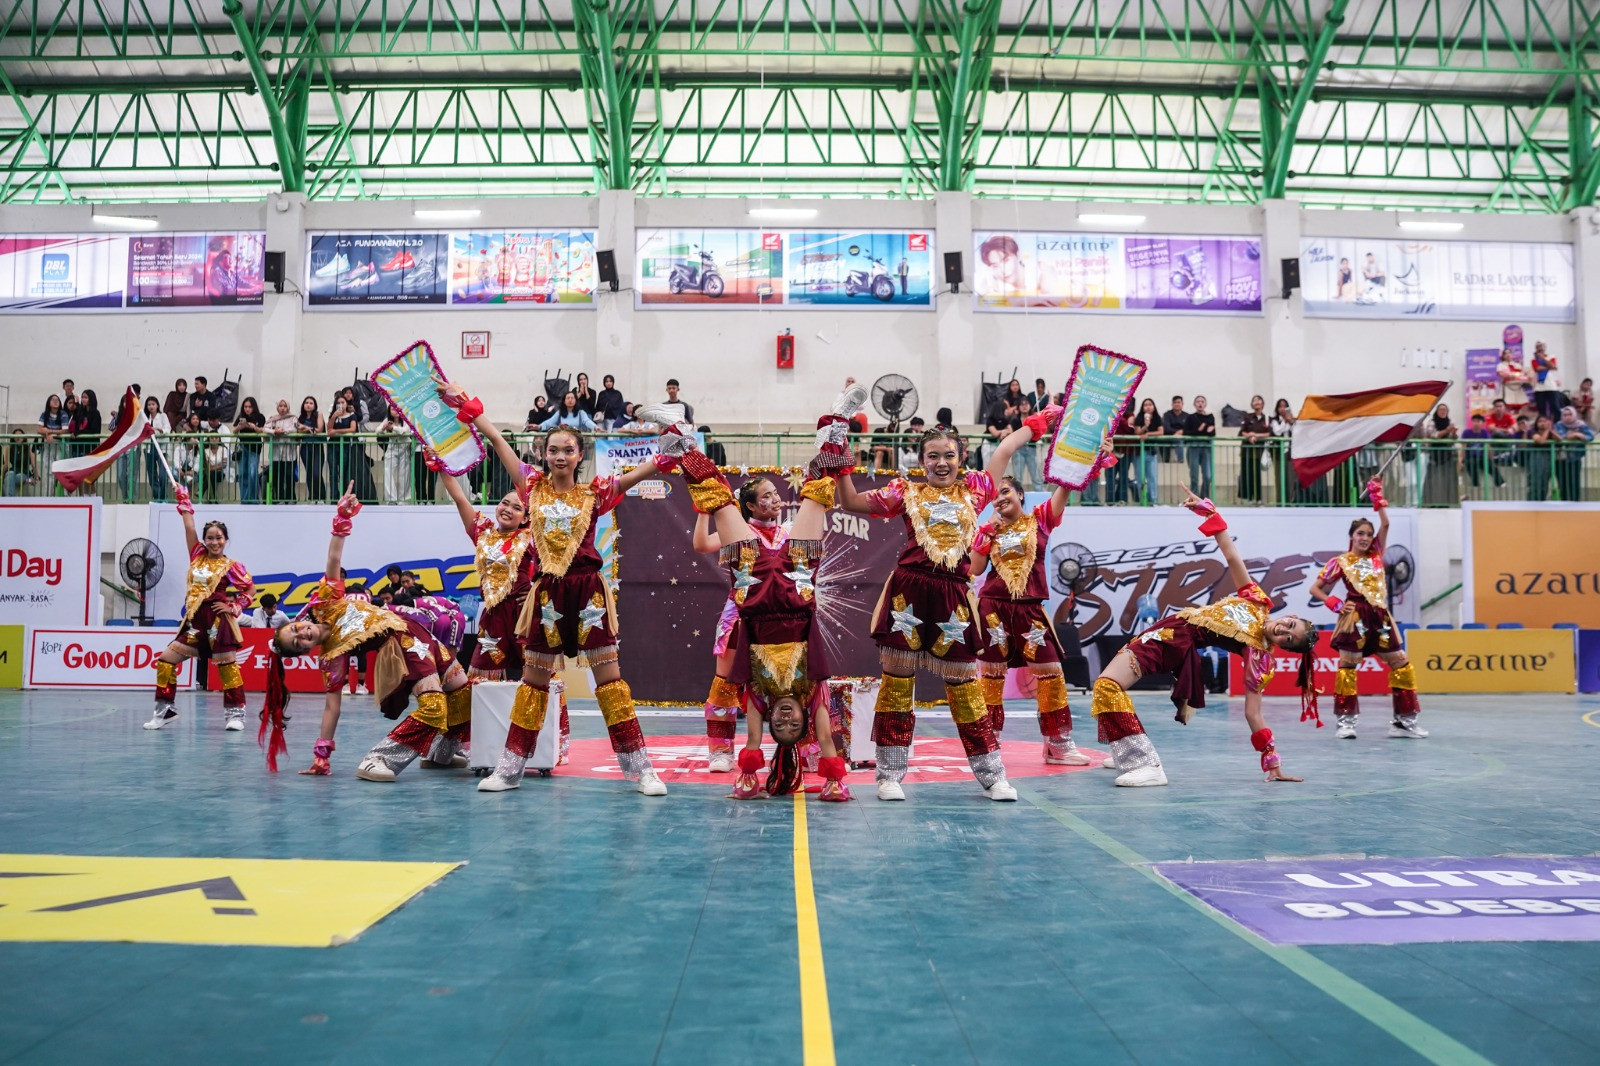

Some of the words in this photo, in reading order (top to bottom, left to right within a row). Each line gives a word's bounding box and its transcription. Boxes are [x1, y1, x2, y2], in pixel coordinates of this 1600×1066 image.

[354, 239, 411, 247] FUNDAMENTAL
[1037, 240, 1110, 252] azarine
[45, 260, 66, 270] DBL
[1453, 272, 1495, 285] RADAR
[1498, 273, 1558, 287] LAMPUNG
[1081, 388, 1116, 404] SUNSCREEN
[607, 447, 653, 458] SMANTA
[831, 511, 870, 541] STAR
[7, 548, 62, 586] Day
[30, 594, 49, 603] RASA
[1426, 653, 1547, 671] azarine
